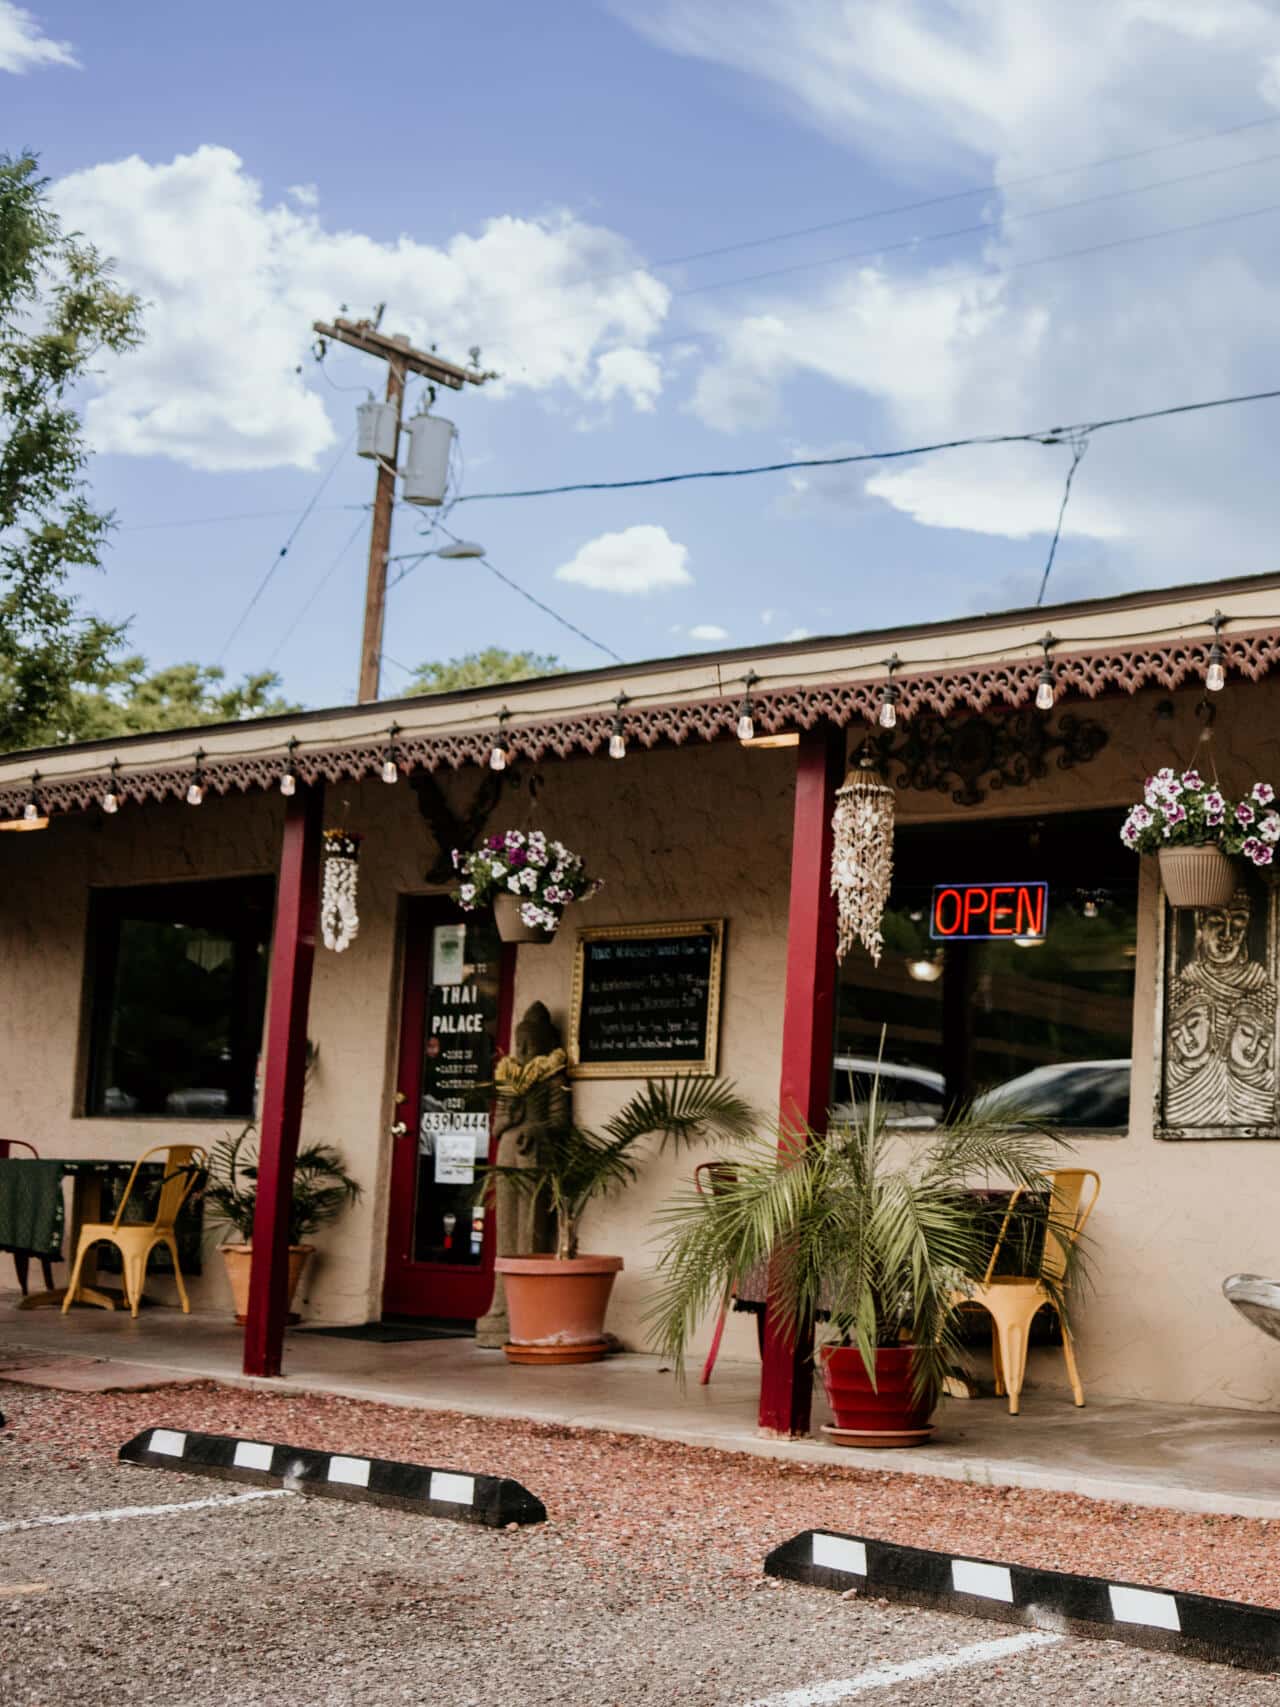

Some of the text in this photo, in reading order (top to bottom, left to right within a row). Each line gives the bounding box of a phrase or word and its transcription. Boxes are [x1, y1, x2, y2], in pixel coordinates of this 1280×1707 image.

[935, 887, 1043, 935] OPEN
[441, 985, 478, 1004] THAI
[432, 1013, 484, 1034] PALACE
